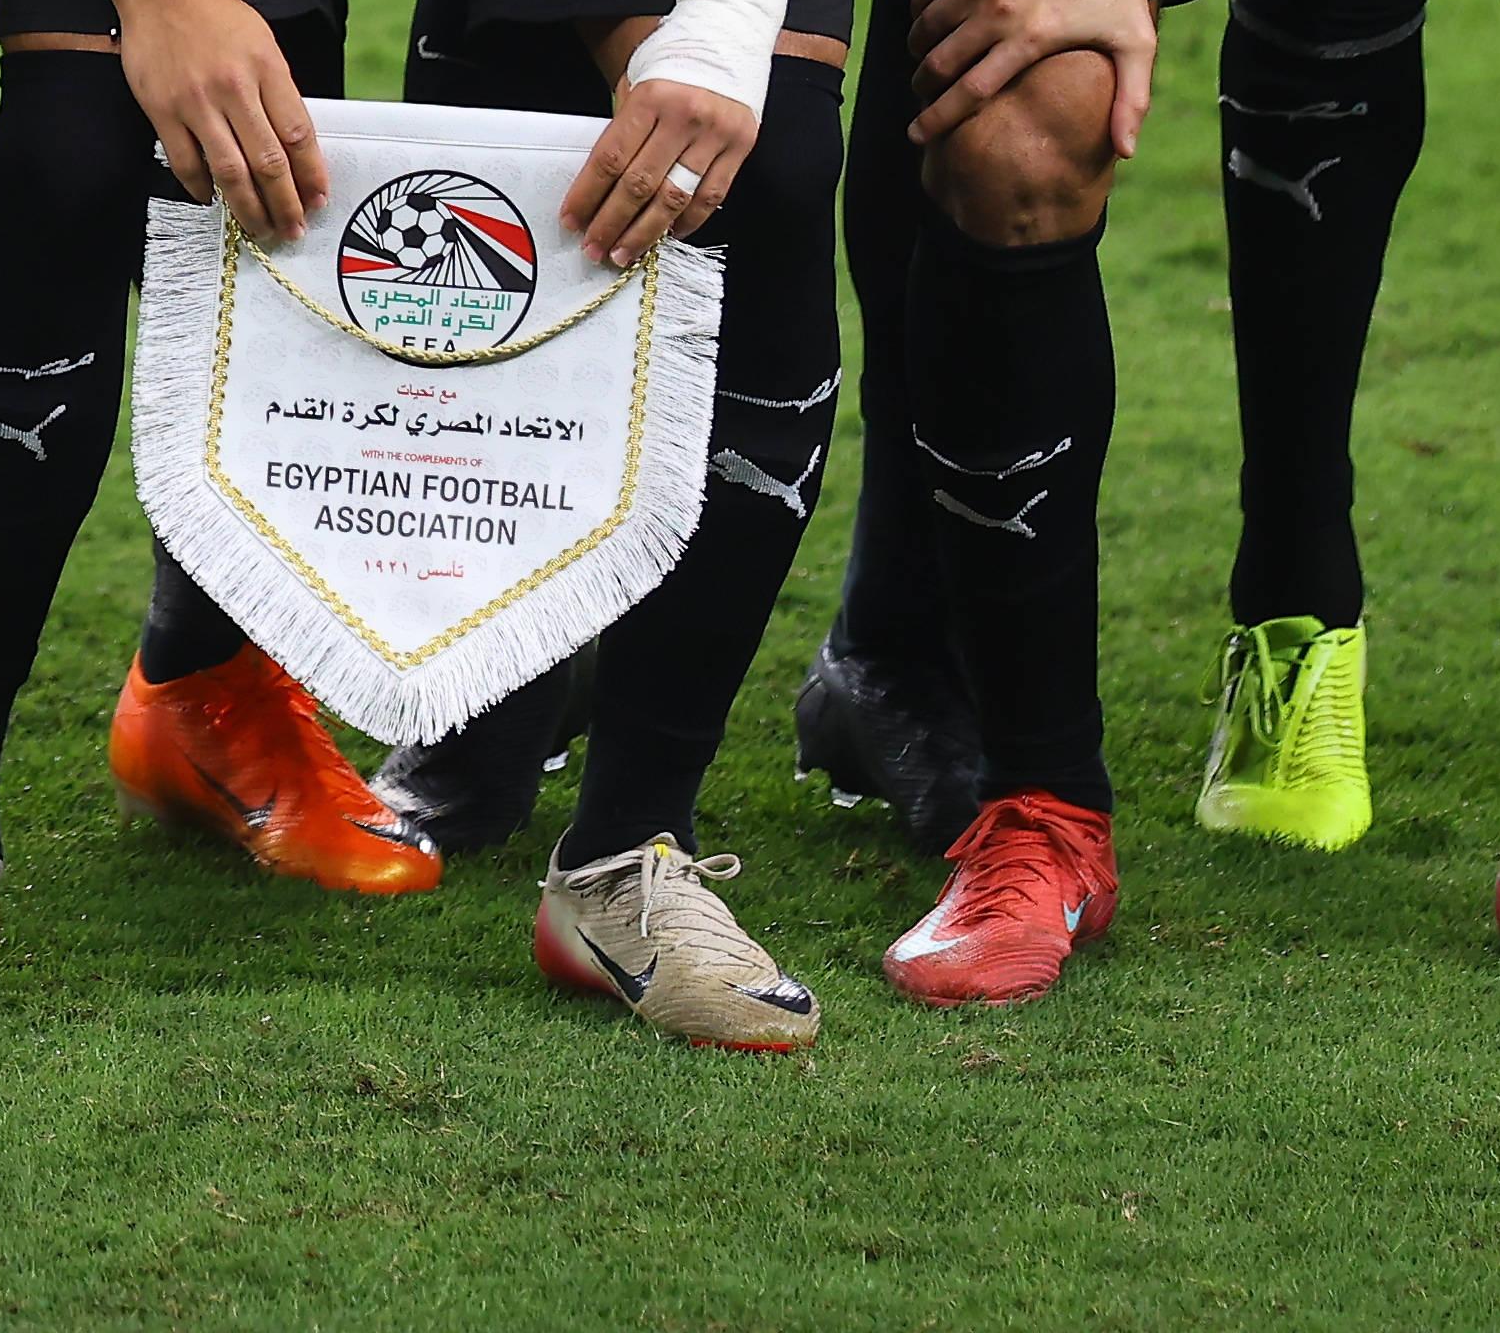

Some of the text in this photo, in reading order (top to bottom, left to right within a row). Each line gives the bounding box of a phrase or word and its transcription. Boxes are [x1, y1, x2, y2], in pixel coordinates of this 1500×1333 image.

[375, 309, 495, 336] لكرة القدم
[396, 384, 457, 404] مع تحيات
[265, 397, 584, 442] الاتحاد المصري لكرة القدم
[361, 449, 483, 467] WITH THE COMPLEMENTS OF
[266, 461, 574, 511] EGYPTIAN FOOTBALL
[314, 505, 517, 546] ASSOCIATION
[417, 560, 464, 581] تأسس
